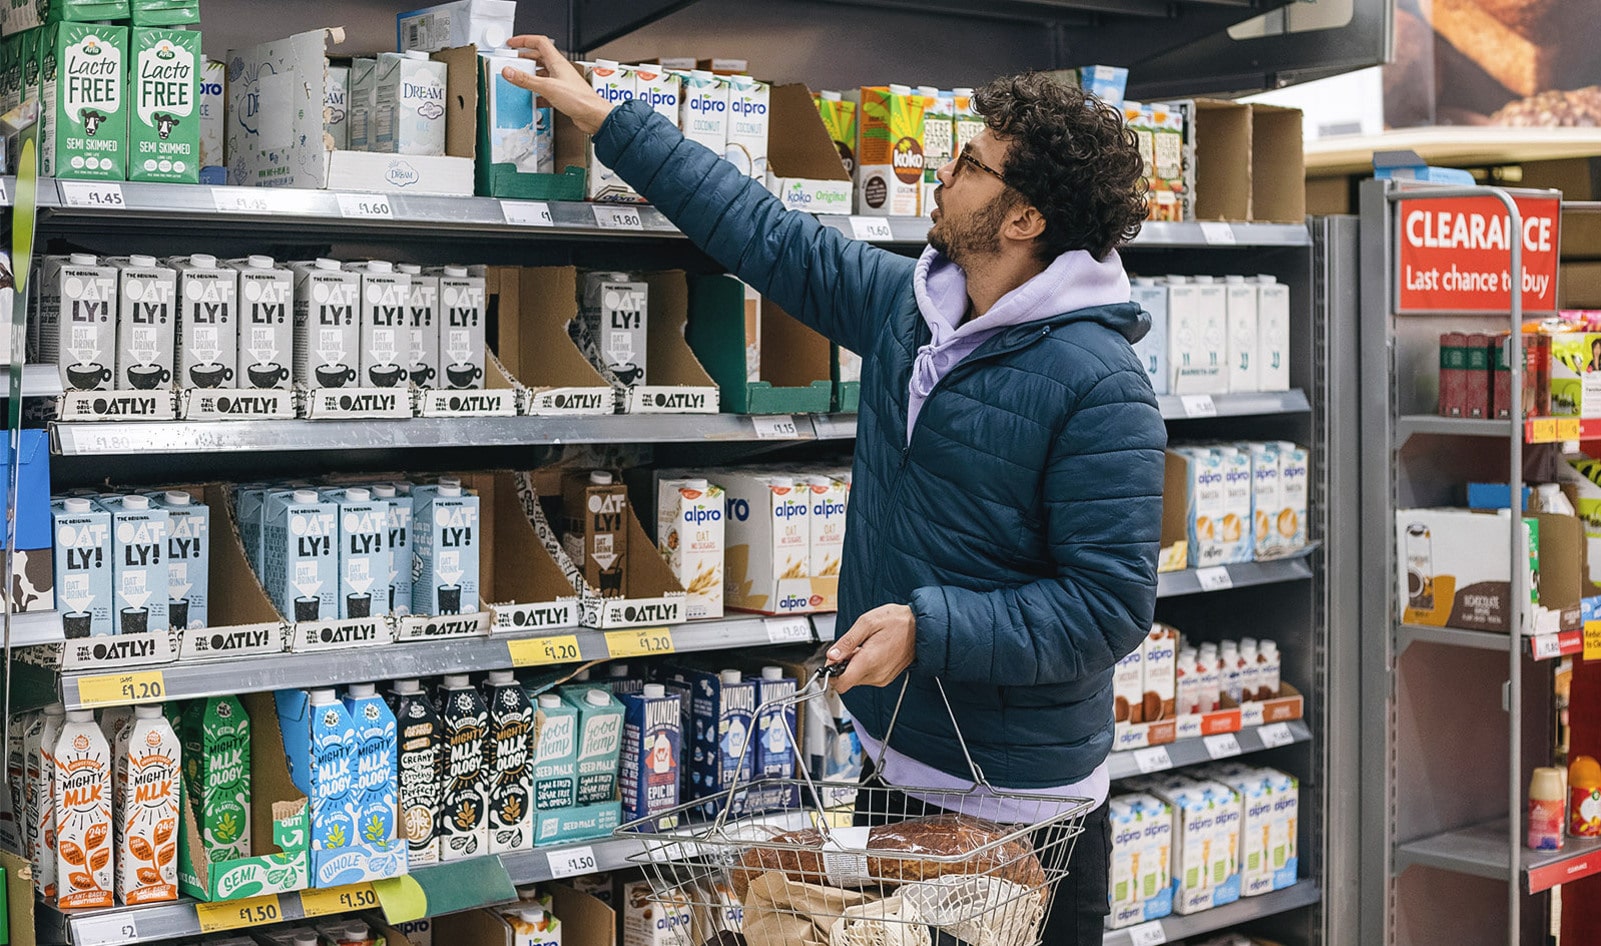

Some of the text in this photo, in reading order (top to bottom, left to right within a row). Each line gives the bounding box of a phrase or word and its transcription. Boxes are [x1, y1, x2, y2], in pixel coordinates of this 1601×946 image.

[68, 55, 117, 75] Lacto
[141, 60, 190, 79] Lacto
[69, 76, 115, 103] FREE
[142, 80, 188, 107] FREE
[404, 83, 444, 101] DREAM
[640, 87, 676, 107] alpro
[690, 95, 725, 114] alpro
[732, 98, 766, 117] alpro
[66, 138, 118, 152] SEMI SKIMMED
[139, 141, 191, 155] SEMI SKIMMED
[894, 149, 923, 168] koko
[89, 191, 122, 205] £1.45
[788, 190, 811, 204] koko
[358, 202, 389, 215] £1.60
[1406, 265, 1439, 291] Last
[1442, 264, 1499, 292] chance
[1522, 265, 1549, 299] buy
[73, 300, 108, 322] LY!
[133, 302, 167, 324] LY!
[194, 302, 228, 323] LY!
[252, 303, 284, 324] LY!
[320, 305, 352, 325] LY!
[373, 305, 403, 326] LY!
[450, 308, 477, 326] LY!
[611, 310, 640, 329] LY!
[93, 398, 156, 415] OATLY!
[217, 397, 277, 414] OATLY!
[339, 395, 395, 411] OATLY!
[450, 396, 501, 411] OATLY!
[554, 394, 602, 408] OATLY!
[655, 393, 704, 408] OATLY!
[684, 505, 721, 526] alpro
[775, 501, 807, 520] alpro
[813, 500, 844, 519] alpro
[594, 513, 621, 532] LY!
[351, 533, 381, 554] LY!
[442, 527, 471, 547] LY!
[696, 530, 709, 542] OAT
[125, 544, 160, 566] LY!
[168, 538, 201, 559] LY!
[299, 536, 330, 557] LY!
[67, 547, 103, 570] LY!
[624, 603, 677, 622] OATLY!
[780, 595, 807, 611] alpro
[513, 607, 568, 627] OATLY!
[320, 624, 376, 643] OATLY!
[425, 620, 478, 635] OATLY!
[211, 630, 269, 650] OATLY!
[640, 637, 670, 652] £1.20
[93, 640, 155, 660] OATLY!
[545, 645, 577, 660] £1.20
[1147, 646, 1173, 665] alpro
[122, 682, 161, 700] £1.20
[645, 700, 680, 730] WUNDA
[450, 728, 484, 746] MIGHTY
[496, 723, 528, 741] MIGHTY
[587, 716, 617, 741] good
[209, 736, 245, 754] MIGHTY
[358, 739, 392, 758] MIGHTY
[318, 746, 351, 766] MIGHTY
[402, 752, 433, 765] CREAMY
[497, 751, 527, 771] OLOGY
[451, 756, 482, 776] OLOGY
[536, 766, 552, 777] SEED
[579, 762, 596, 773] SEED
[63, 772, 104, 791] MIGHTY
[134, 768, 174, 787] MIGHTY
[210, 765, 243, 787] OLOGY
[358, 767, 391, 790] OLOGY
[135, 780, 172, 805] M.LK
[319, 775, 352, 798] OLOGY
[648, 784, 674, 799] EPIC IN
[64, 785, 103, 809] M.LK
[323, 855, 360, 879] WHOLE
[568, 856, 594, 872] £1.50
[224, 867, 256, 890] SEMI
[340, 889, 376, 907] £1.50
[239, 904, 277, 922] £1.50
[121, 925, 136, 938] £2
